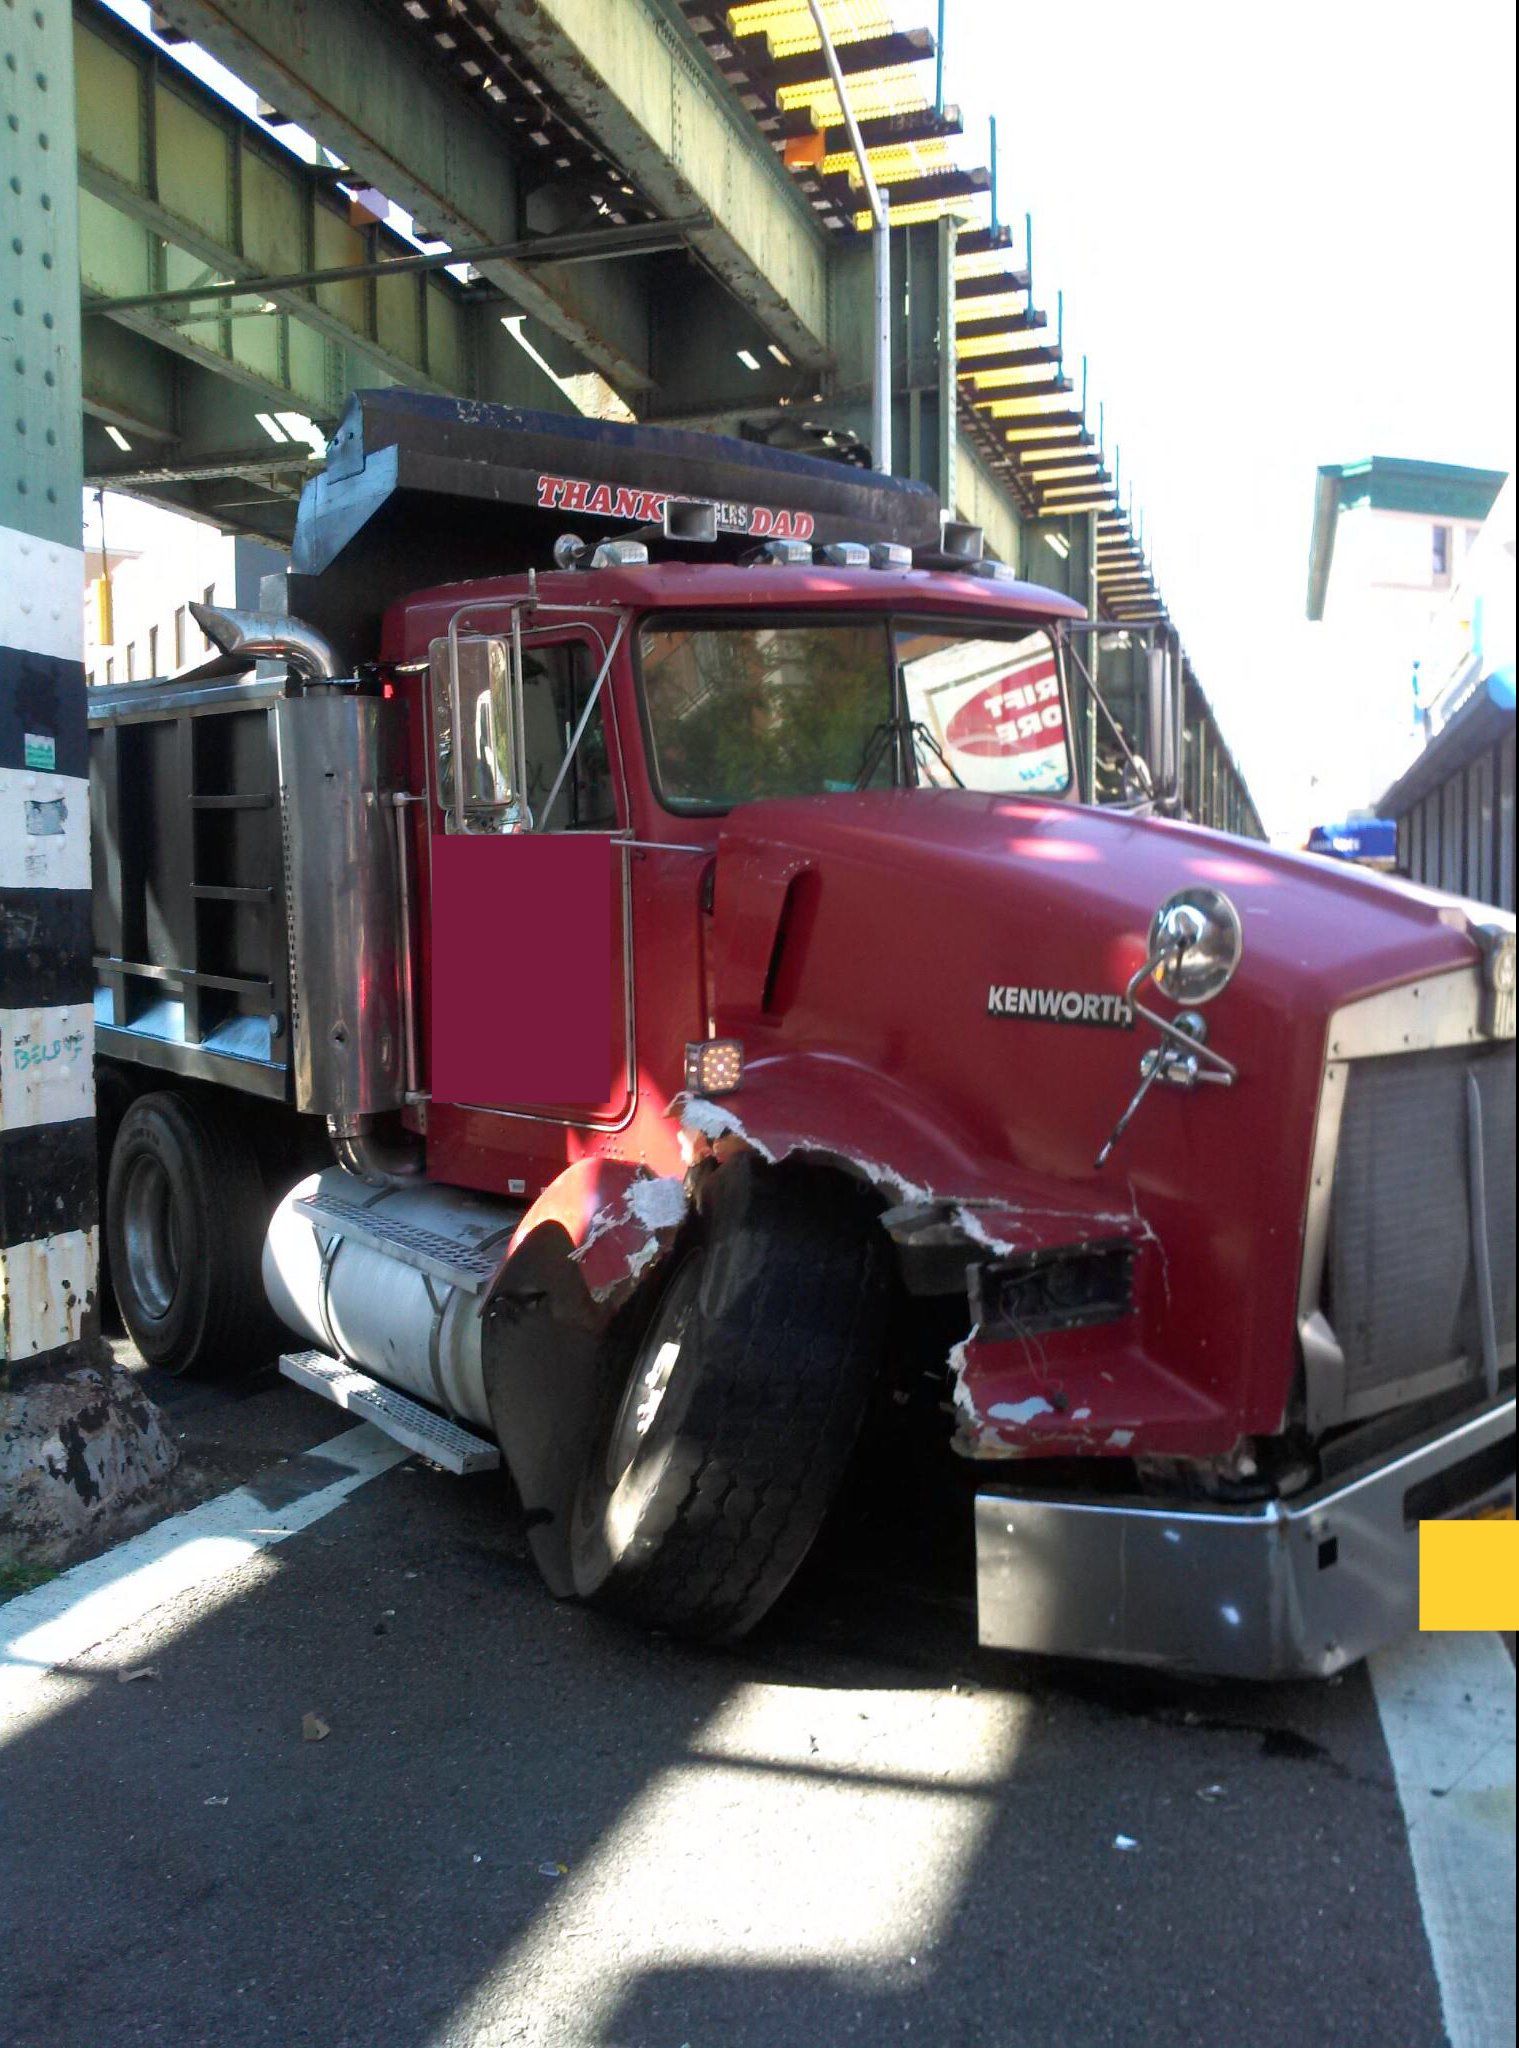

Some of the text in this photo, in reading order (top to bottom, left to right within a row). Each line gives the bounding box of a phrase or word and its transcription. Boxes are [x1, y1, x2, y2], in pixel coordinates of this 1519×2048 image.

[537, 474, 668, 523] THANK
[749, 506, 815, 542] DAD
[988, 984, 1134, 1025] KENWORTH
